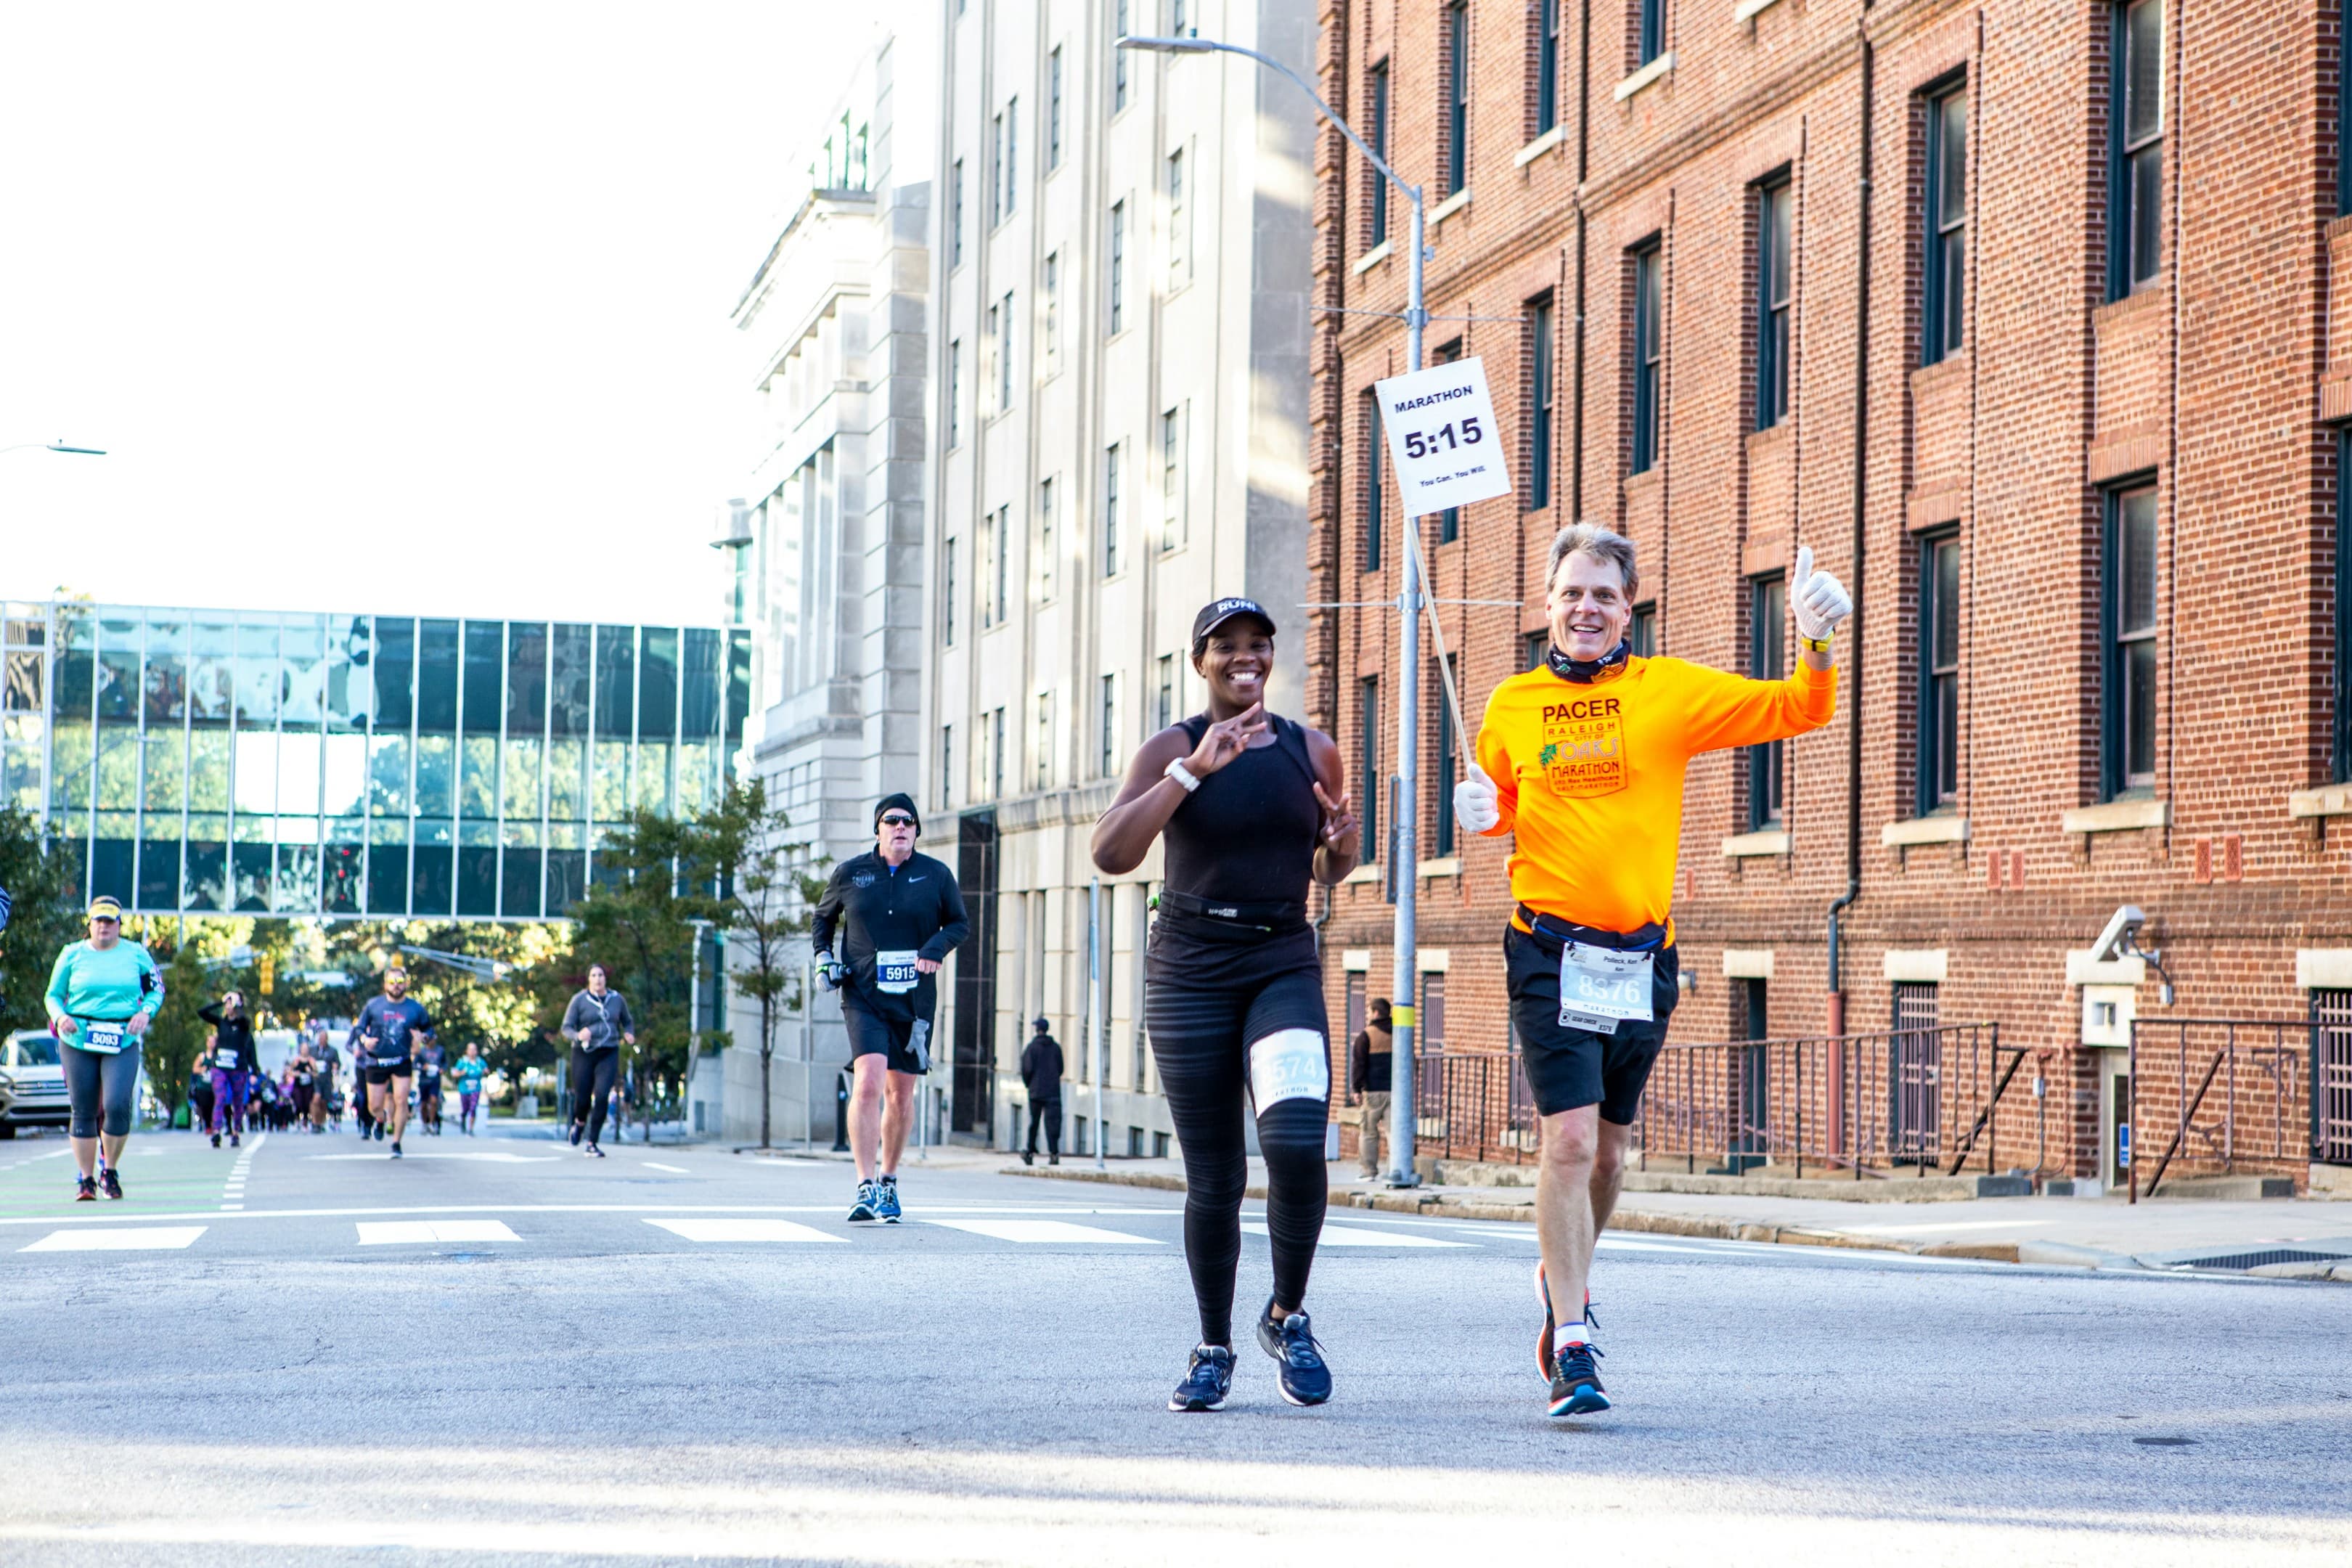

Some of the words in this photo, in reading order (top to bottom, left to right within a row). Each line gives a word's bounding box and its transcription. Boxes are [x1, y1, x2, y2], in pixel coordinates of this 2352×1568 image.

[1395, 385, 1474, 414] MARATHON
[1405, 417, 1482, 459] 5:15
[1470, 465, 1486, 474] Will.
[1543, 698, 1620, 723] PACER
[1548, 722, 1615, 735] RALEIGH
[1561, 738, 1619, 760] OAKS
[1552, 761, 1620, 778] MARATHON
[886, 967, 915, 980] 5915
[1578, 974, 1641, 1003] 8376
[91, 1032, 118, 1045] 5093
